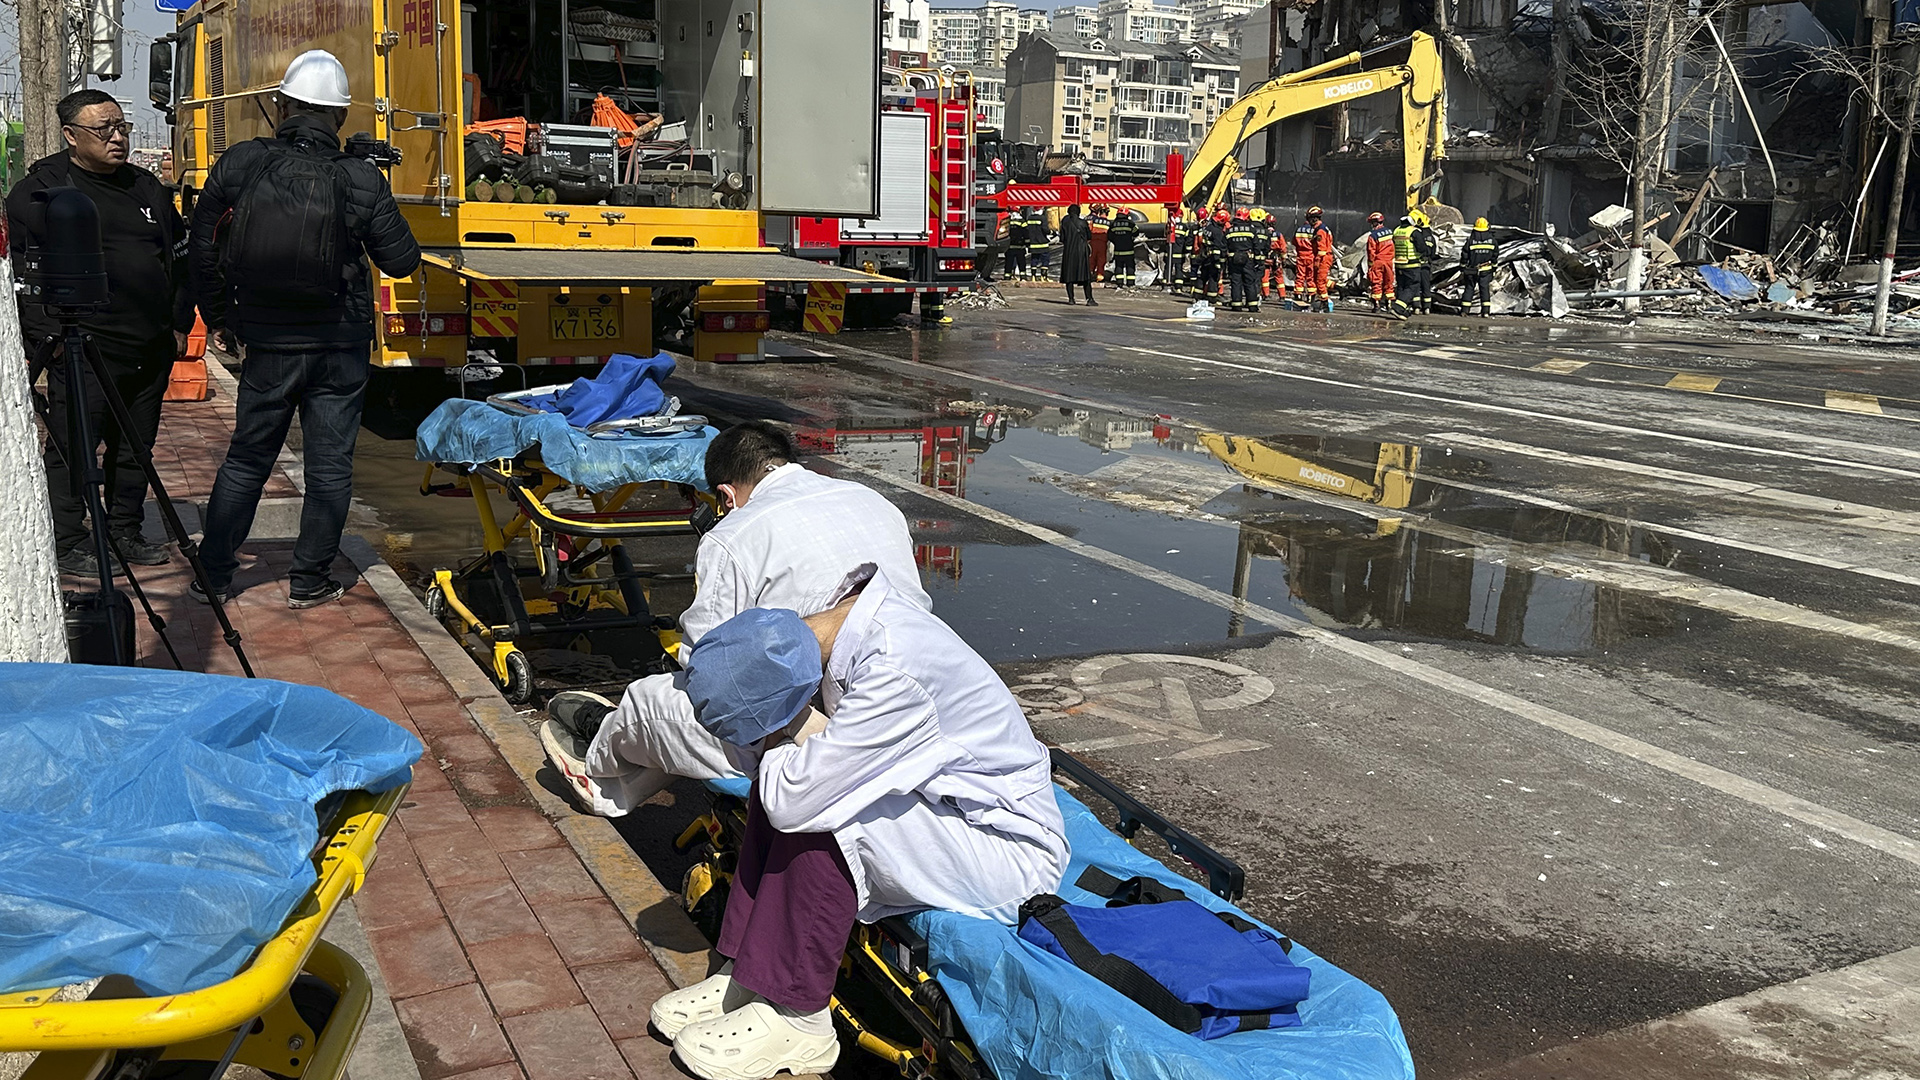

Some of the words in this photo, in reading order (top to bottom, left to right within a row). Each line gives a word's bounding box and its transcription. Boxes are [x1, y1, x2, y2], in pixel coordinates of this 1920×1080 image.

[404, 0, 434, 49] 中国
[1323, 78, 1374, 99] KOBELCO
[995, 161, 1002, 171] 8
[554, 319, 617, 338] K7136
